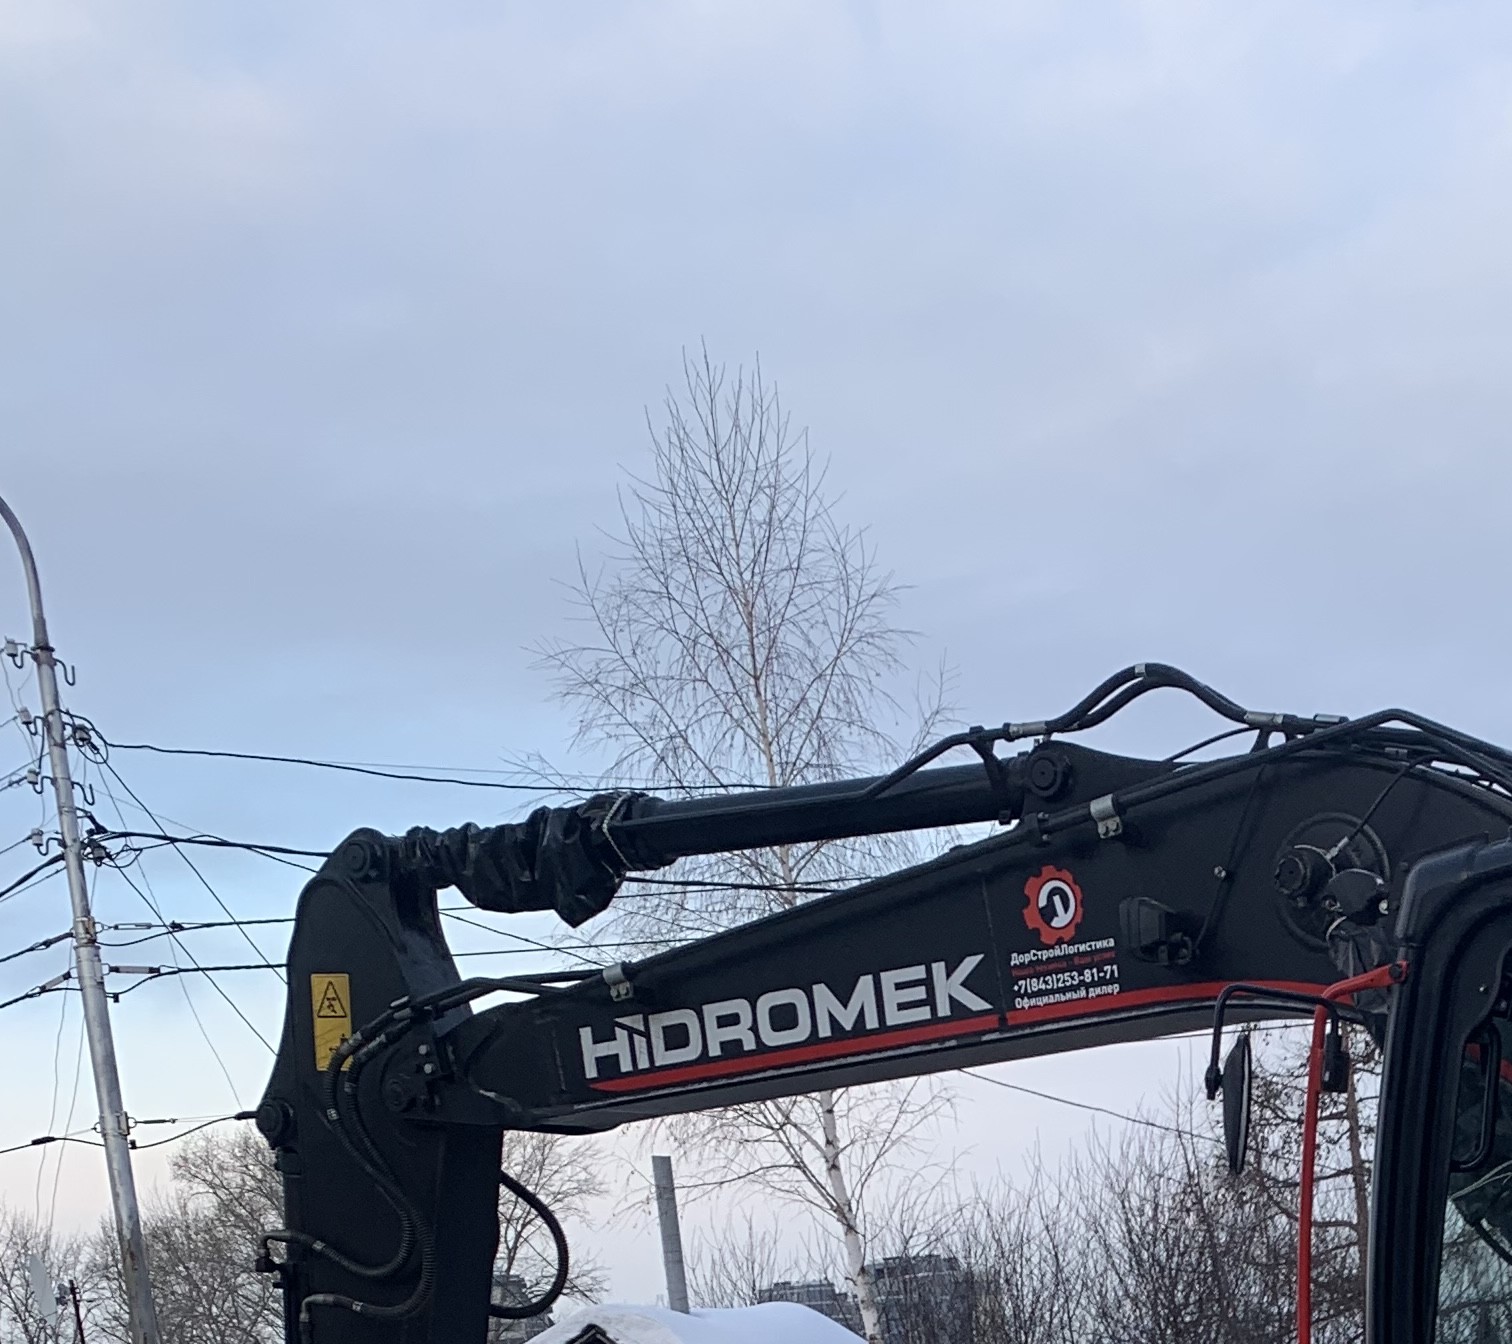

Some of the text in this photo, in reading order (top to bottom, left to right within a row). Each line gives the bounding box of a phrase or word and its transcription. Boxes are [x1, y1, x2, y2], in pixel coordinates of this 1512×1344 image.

[1010, 938, 1115, 966] ДорСтройЛогистика
[1013, 964, 1119, 994] +7(843)253-81-71
[1014, 983, 1120, 1010] Официальный дилер
